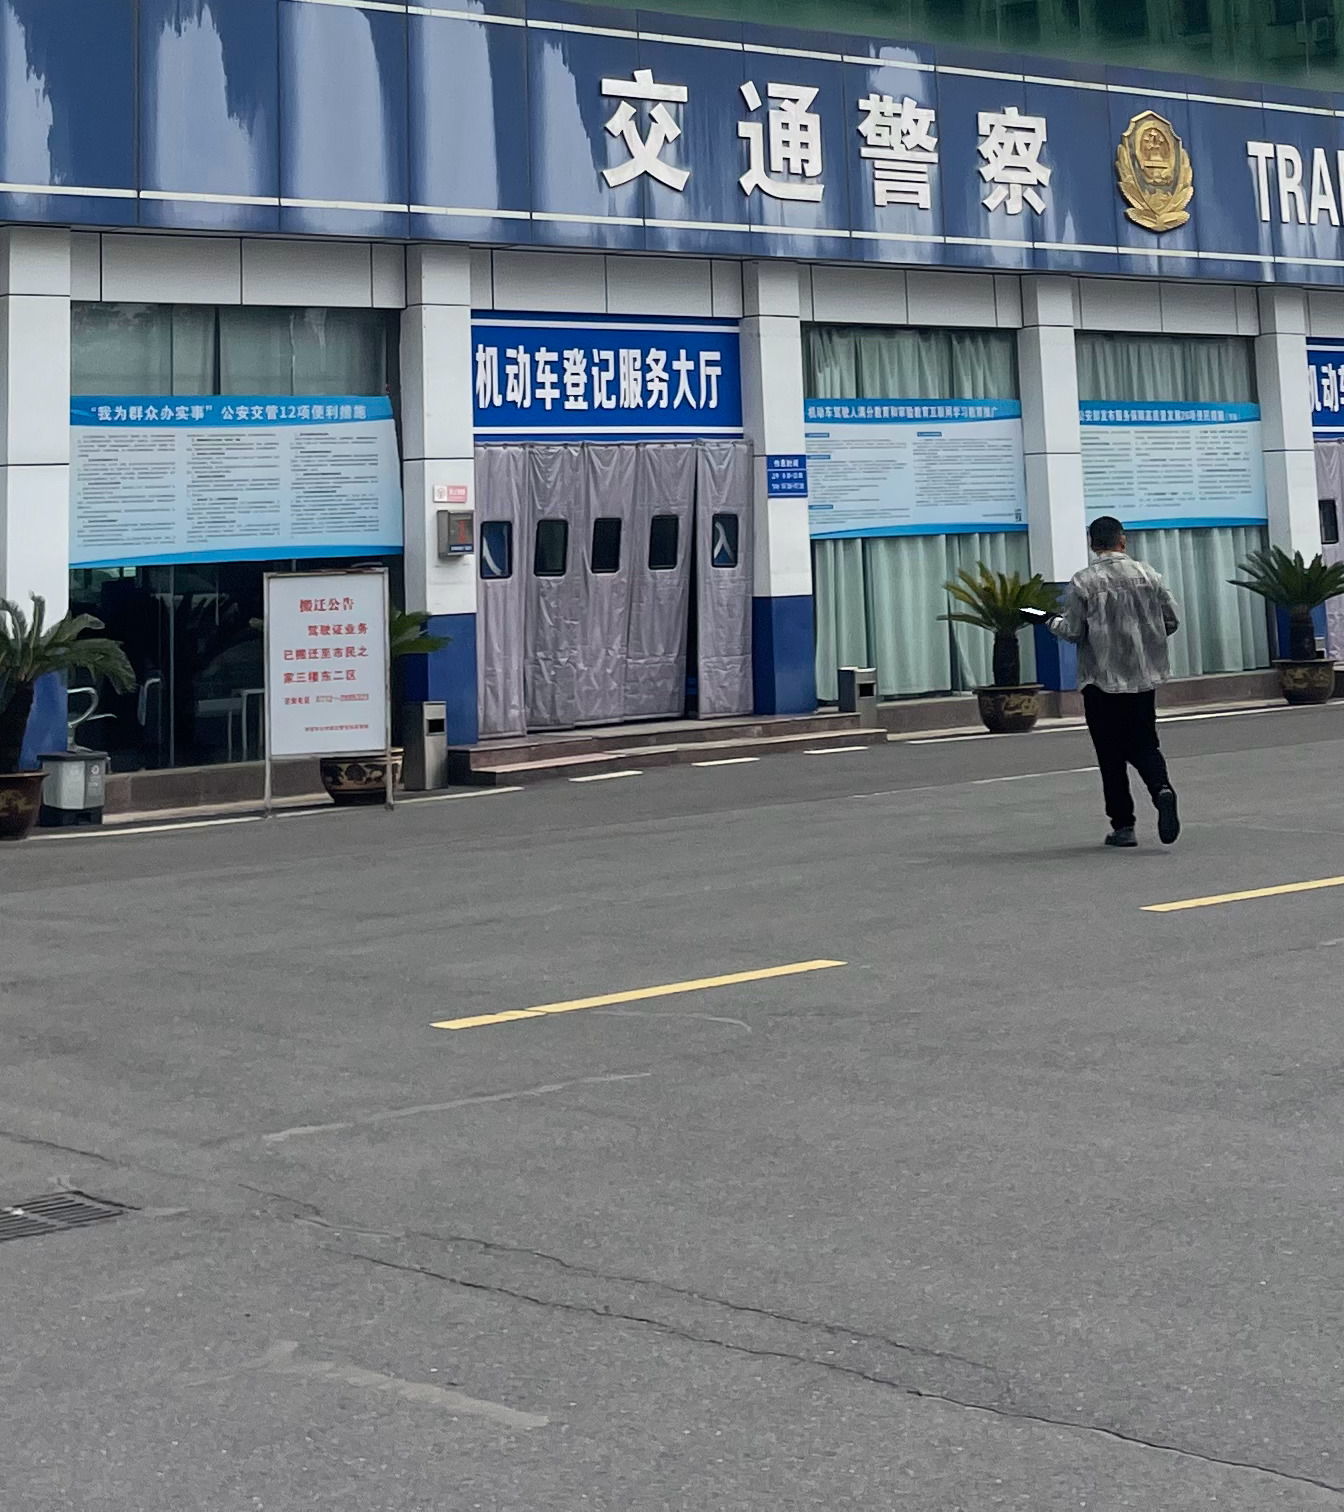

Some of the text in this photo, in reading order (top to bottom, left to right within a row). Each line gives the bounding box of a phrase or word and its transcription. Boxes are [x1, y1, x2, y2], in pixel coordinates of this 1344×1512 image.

[601, 69, 1051, 215] 交通警察
[475, 344, 721, 410] 机动车登记服务大厅
[299, 597, 355, 612] 搬迁公告
[308, 622, 368, 636] 驾驶证业务
[283, 646, 369, 661] 已搬迁至市民之
